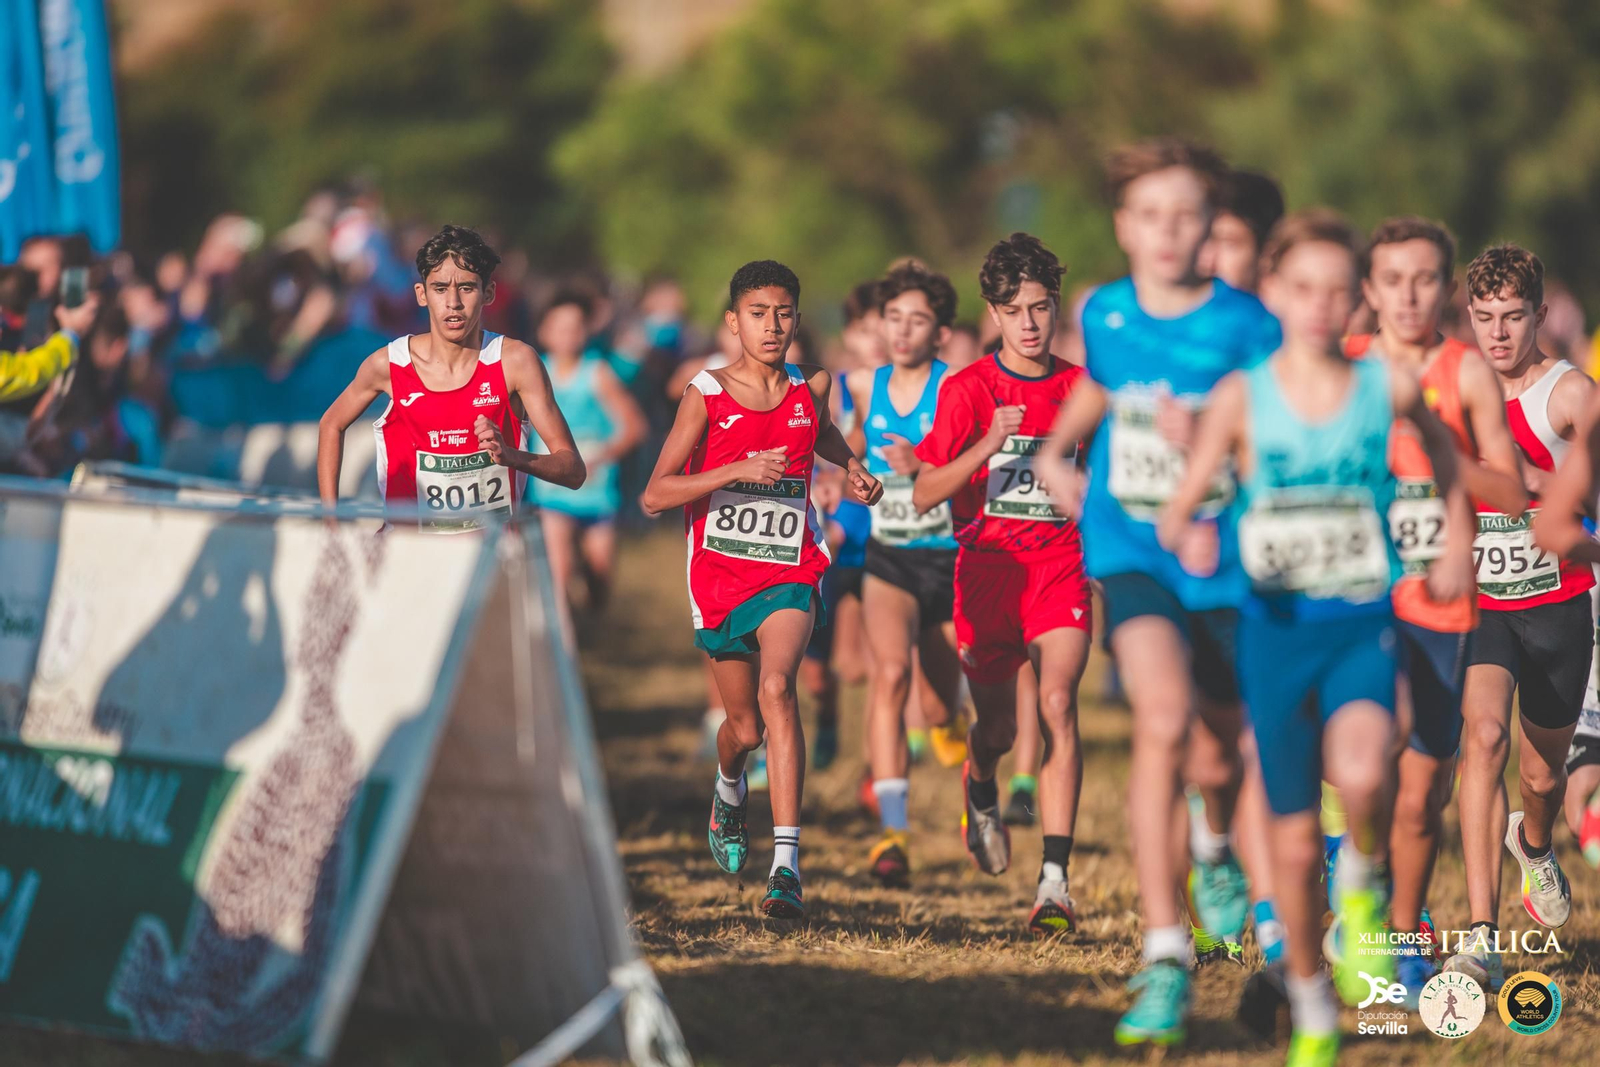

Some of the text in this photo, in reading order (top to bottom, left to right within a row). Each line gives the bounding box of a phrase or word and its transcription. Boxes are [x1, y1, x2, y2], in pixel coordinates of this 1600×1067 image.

[440, 429, 469, 437] Ayuntamiento
[440, 455, 484, 468] ITÁLICA
[427, 477, 504, 511] 8012
[715, 504, 798, 539] 8010
[1480, 516, 1526, 528] ITÁLICA
[1472, 544, 1551, 575] 7952
